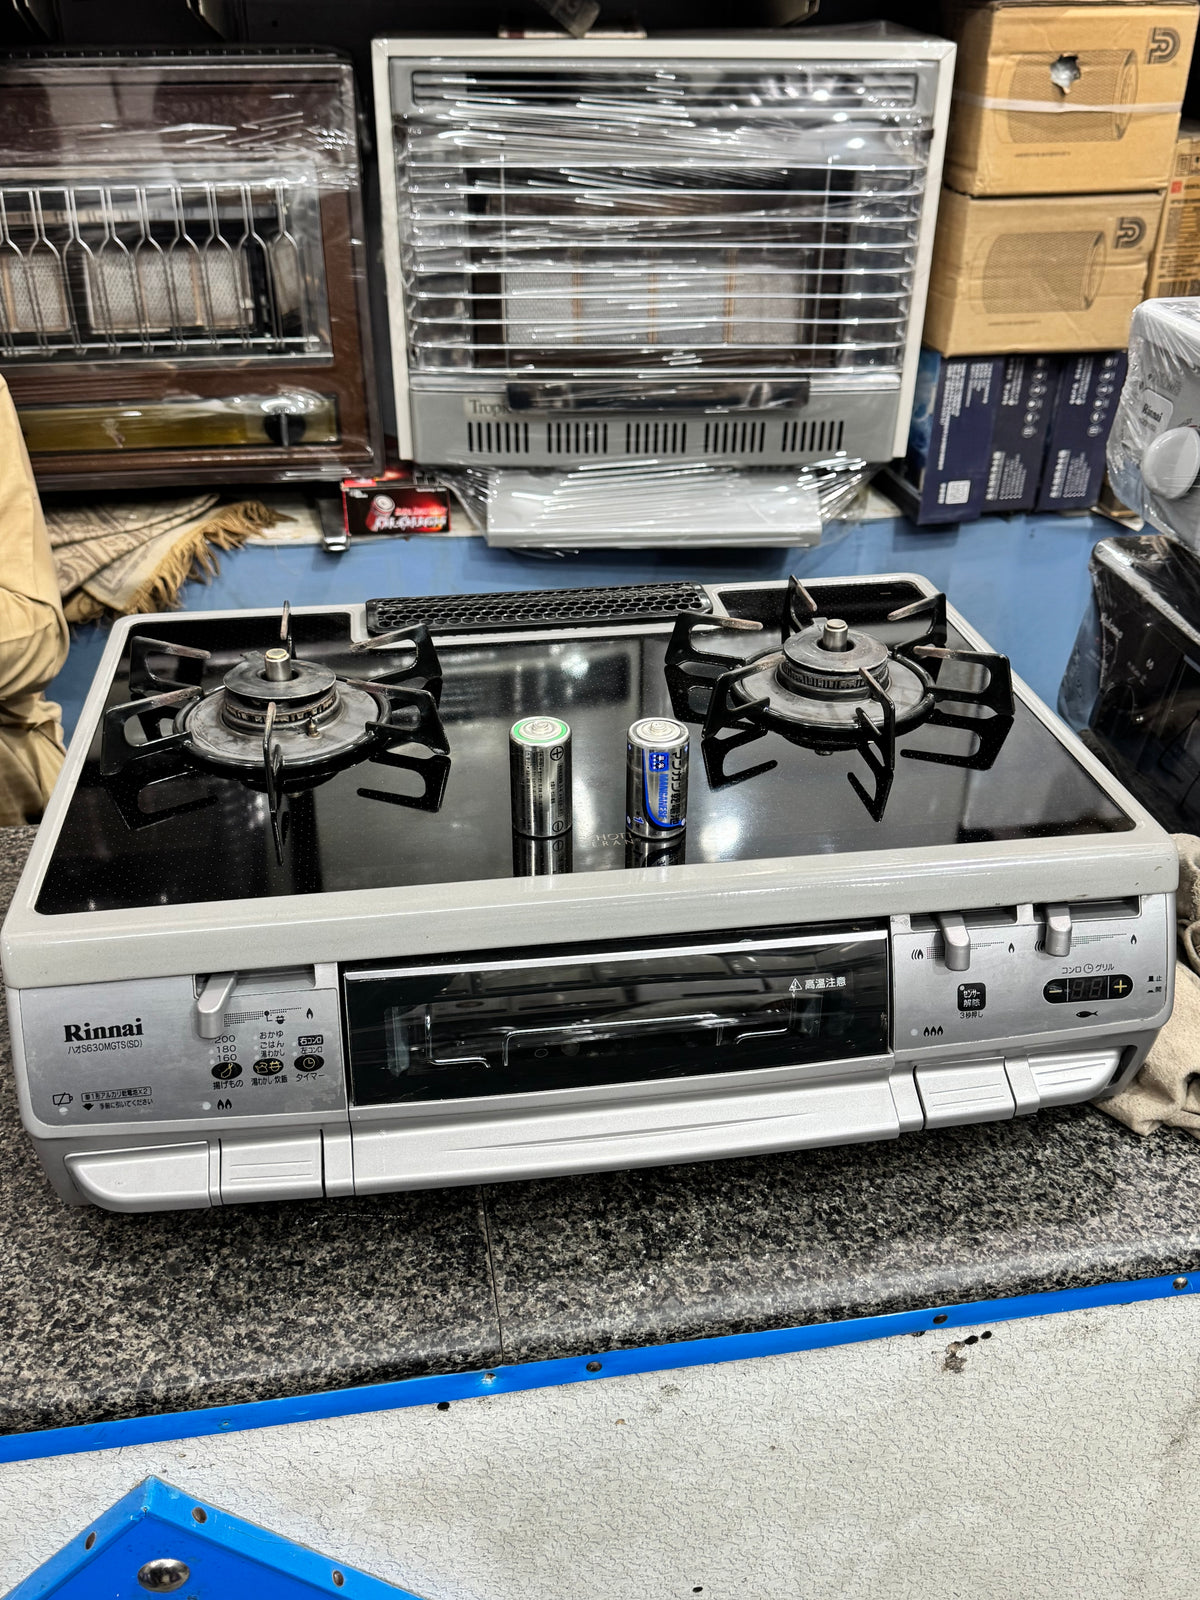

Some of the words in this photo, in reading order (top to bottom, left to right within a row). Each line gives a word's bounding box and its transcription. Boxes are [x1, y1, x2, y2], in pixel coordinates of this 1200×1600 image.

[658, 773, 668, 819] MANGANESE
[1061, 965, 1082, 975] コンロ
[1095, 963, 1115, 972] グリル
[804, 976, 847, 990] 高温注意
[963, 989, 981, 998] センサー
[63, 1017, 145, 1043] Rinnai
[259, 1030, 284, 1040] おかゆ
[214, 1034, 236, 1044] 200
[216, 1045, 237, 1054] 180
[260, 1040, 285, 1049] ごはん
[217, 1053, 238, 1062] 160
[295, 1072, 325, 1083] タイマー
[213, 1079, 244, 1091] 揚げもの
